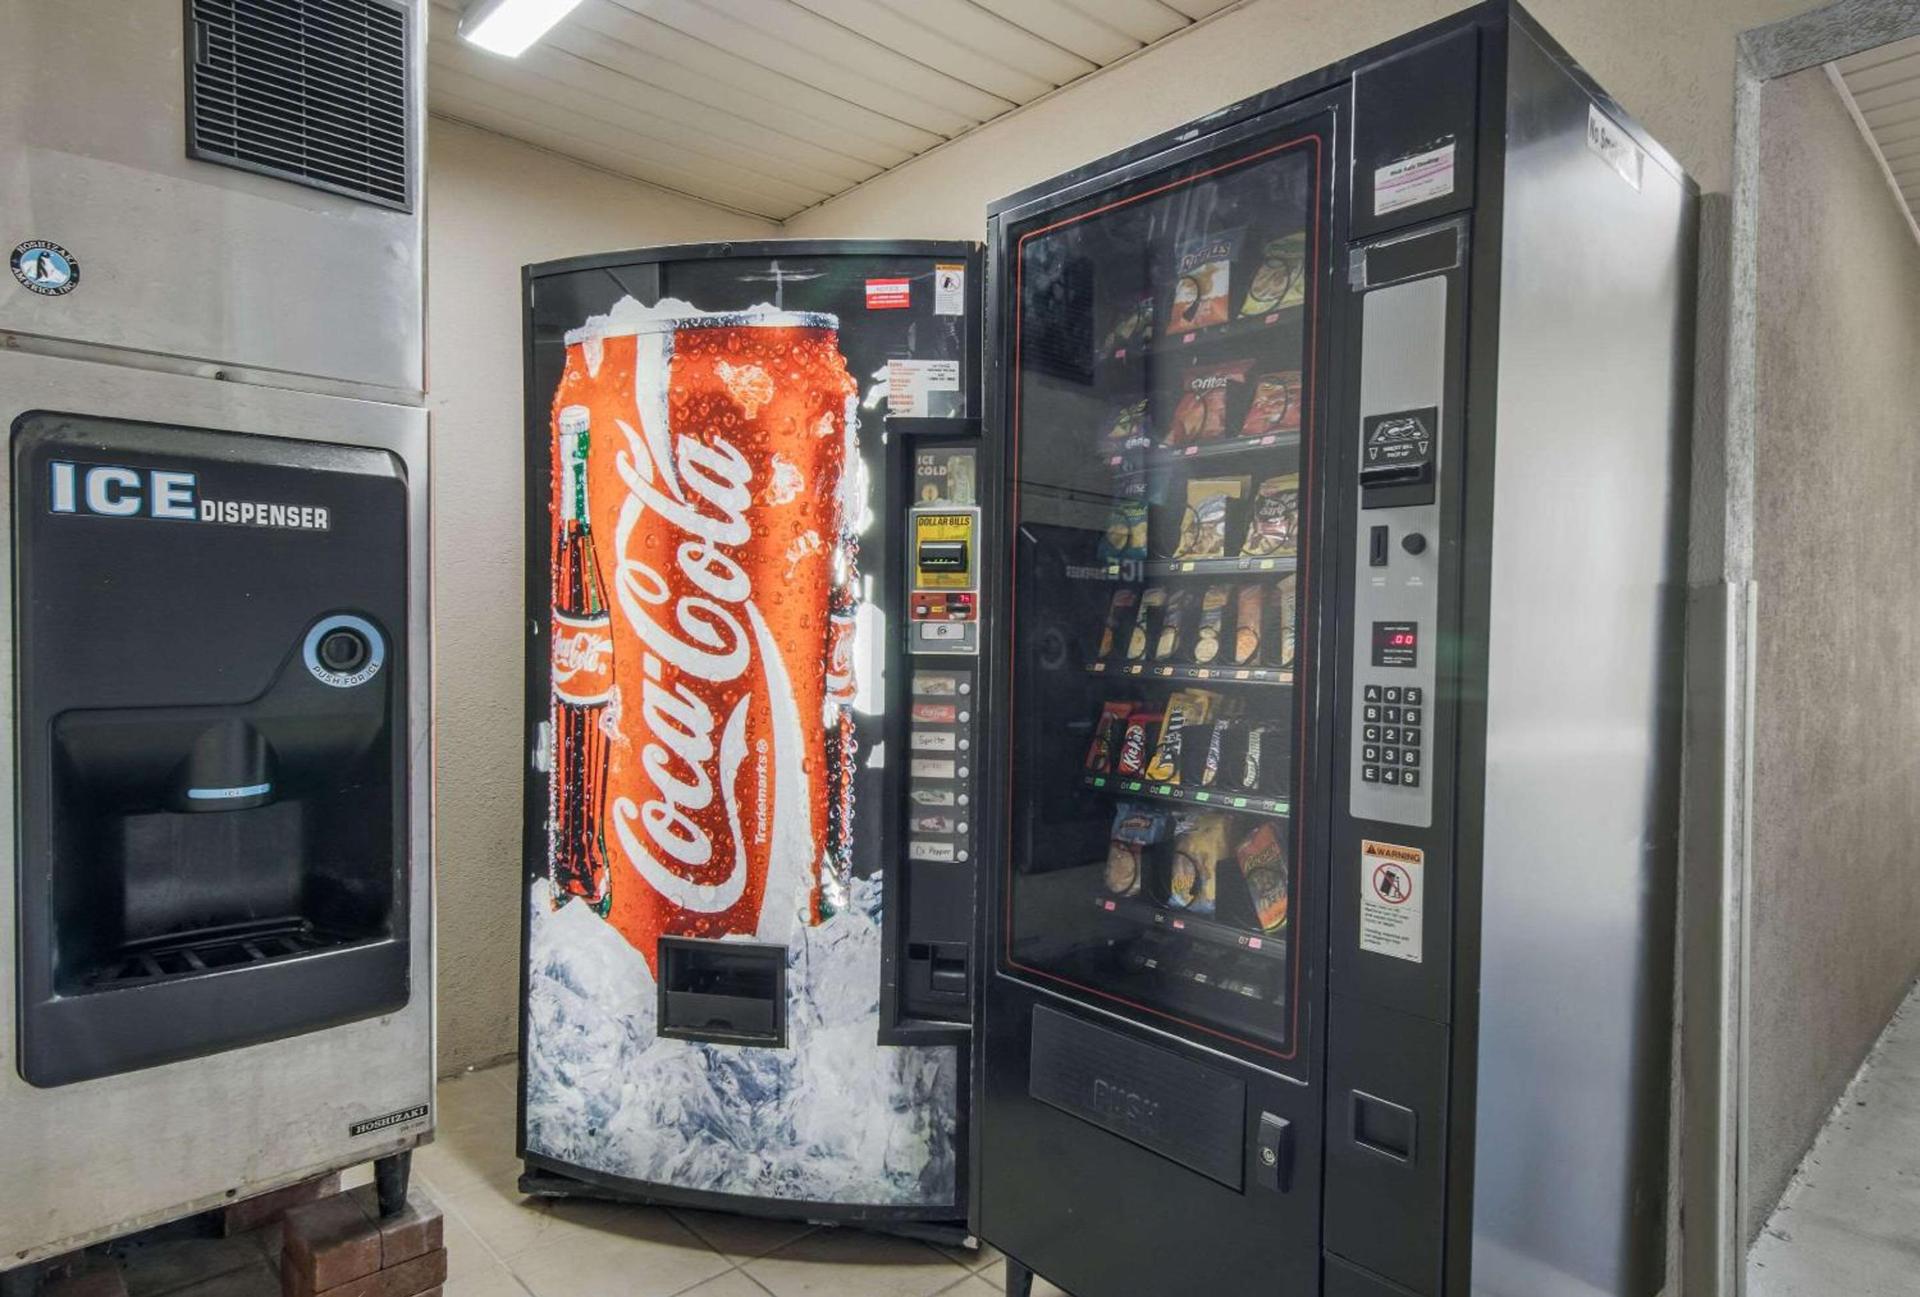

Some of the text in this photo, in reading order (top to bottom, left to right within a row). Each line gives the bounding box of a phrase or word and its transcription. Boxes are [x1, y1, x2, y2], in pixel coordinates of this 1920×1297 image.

[917, 455, 935, 465] ICE
[917, 466, 948, 476] COLD
[48, 460, 197, 521] ICE
[200, 499, 330, 530] DISPENSER
[918, 516, 971, 527] DOLLAR BILLS
[612, 418, 753, 915] Coca-Cola
[312, 662, 379, 686] PUSH FOR ICE
[1367, 689, 1416, 702] A 0 5
[1367, 709, 1415, 722] B 1 6
[918, 733, 947, 746] Sprite
[1366, 729, 1414, 742] C 2 7
[1366, 749, 1414, 763] D 3 8
[1365, 769, 1413, 783] E 4 9
[928, 847, 952, 860] Pepper
[1377, 847, 1420, 862] WARNING
[355, 1107, 426, 1134] HOSHIZAKI
